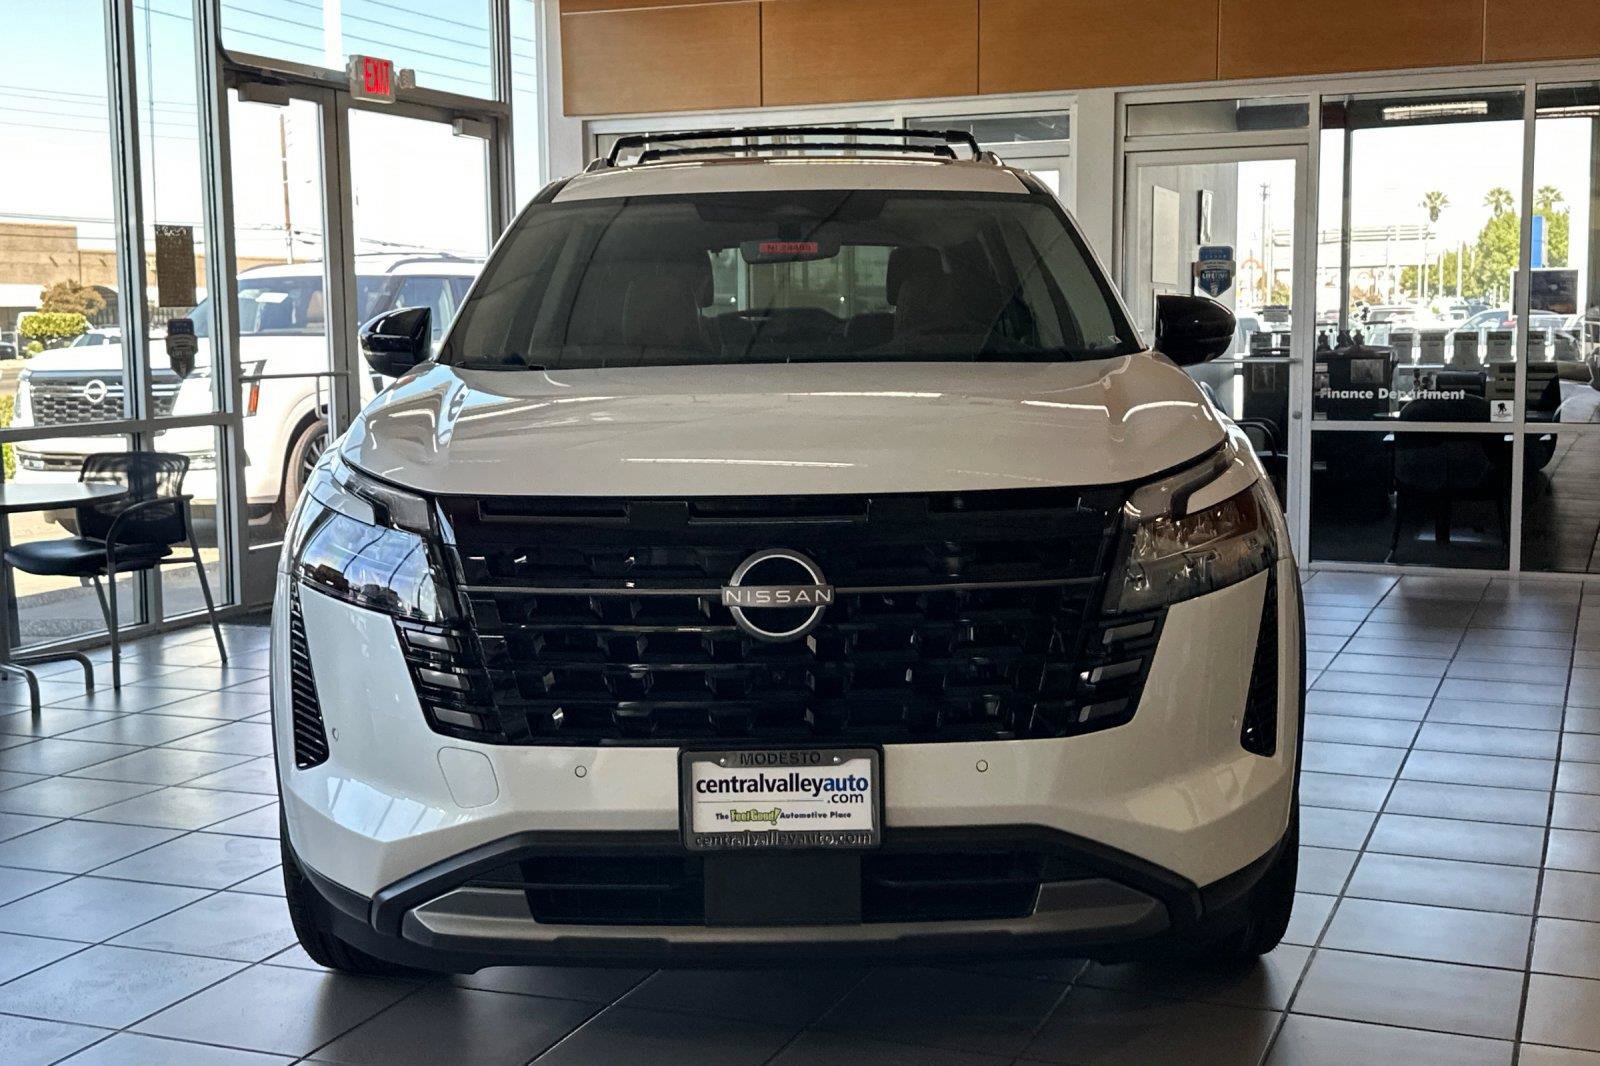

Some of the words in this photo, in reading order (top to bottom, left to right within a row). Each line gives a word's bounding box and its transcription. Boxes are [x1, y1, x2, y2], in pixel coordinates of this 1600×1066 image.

[364, 56, 390, 96] EXIT
[1320, 388, 1374, 399] Finance
[1378, 388, 1466, 401] Department
[725, 589, 831, 603] NISSAN
[740, 751, 822, 766] MODESTO
[696, 773, 869, 797] centralvalleyauto
[827, 792, 864, 804] .com
[716, 812, 729, 820] The
[780, 811, 828, 819] Automotive
